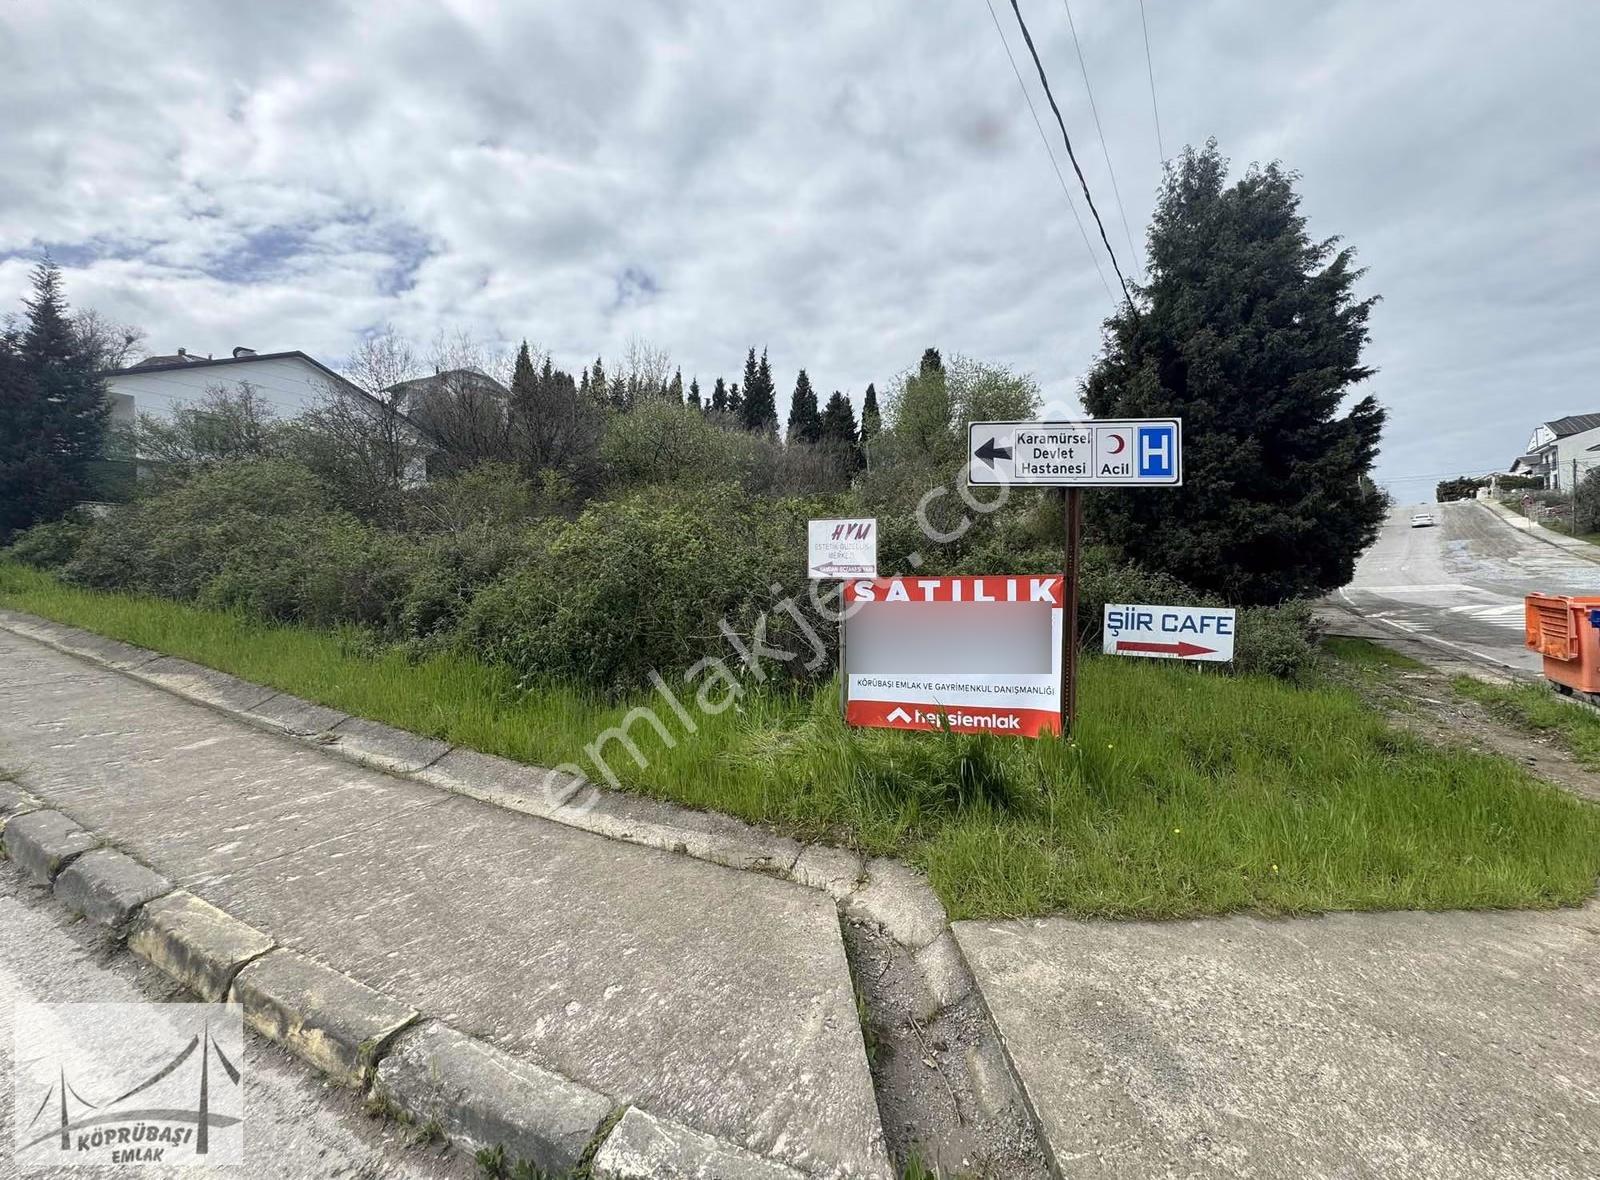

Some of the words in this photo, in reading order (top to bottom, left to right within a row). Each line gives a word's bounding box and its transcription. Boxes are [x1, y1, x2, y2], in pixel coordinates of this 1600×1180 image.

[1017, 433, 1090, 444] Karamürsel
[1033, 448, 1073, 459] Devlet
[1142, 435, 1169, 469] H
[1022, 462, 1086, 474] Hastanesi
[1101, 463, 1129, 475] Acil
[831, 523, 871, 540] HYM
[854, 579, 1057, 604] SATILIK
[1161, 614, 1233, 635] CAFE
[895, 680, 921, 690] EMLAK
[923, 683, 933, 691] VE
[935, 682, 992, 693] GAYRİMENKUL
[994, 685, 1055, 696] DANIŞMANLIĞI
